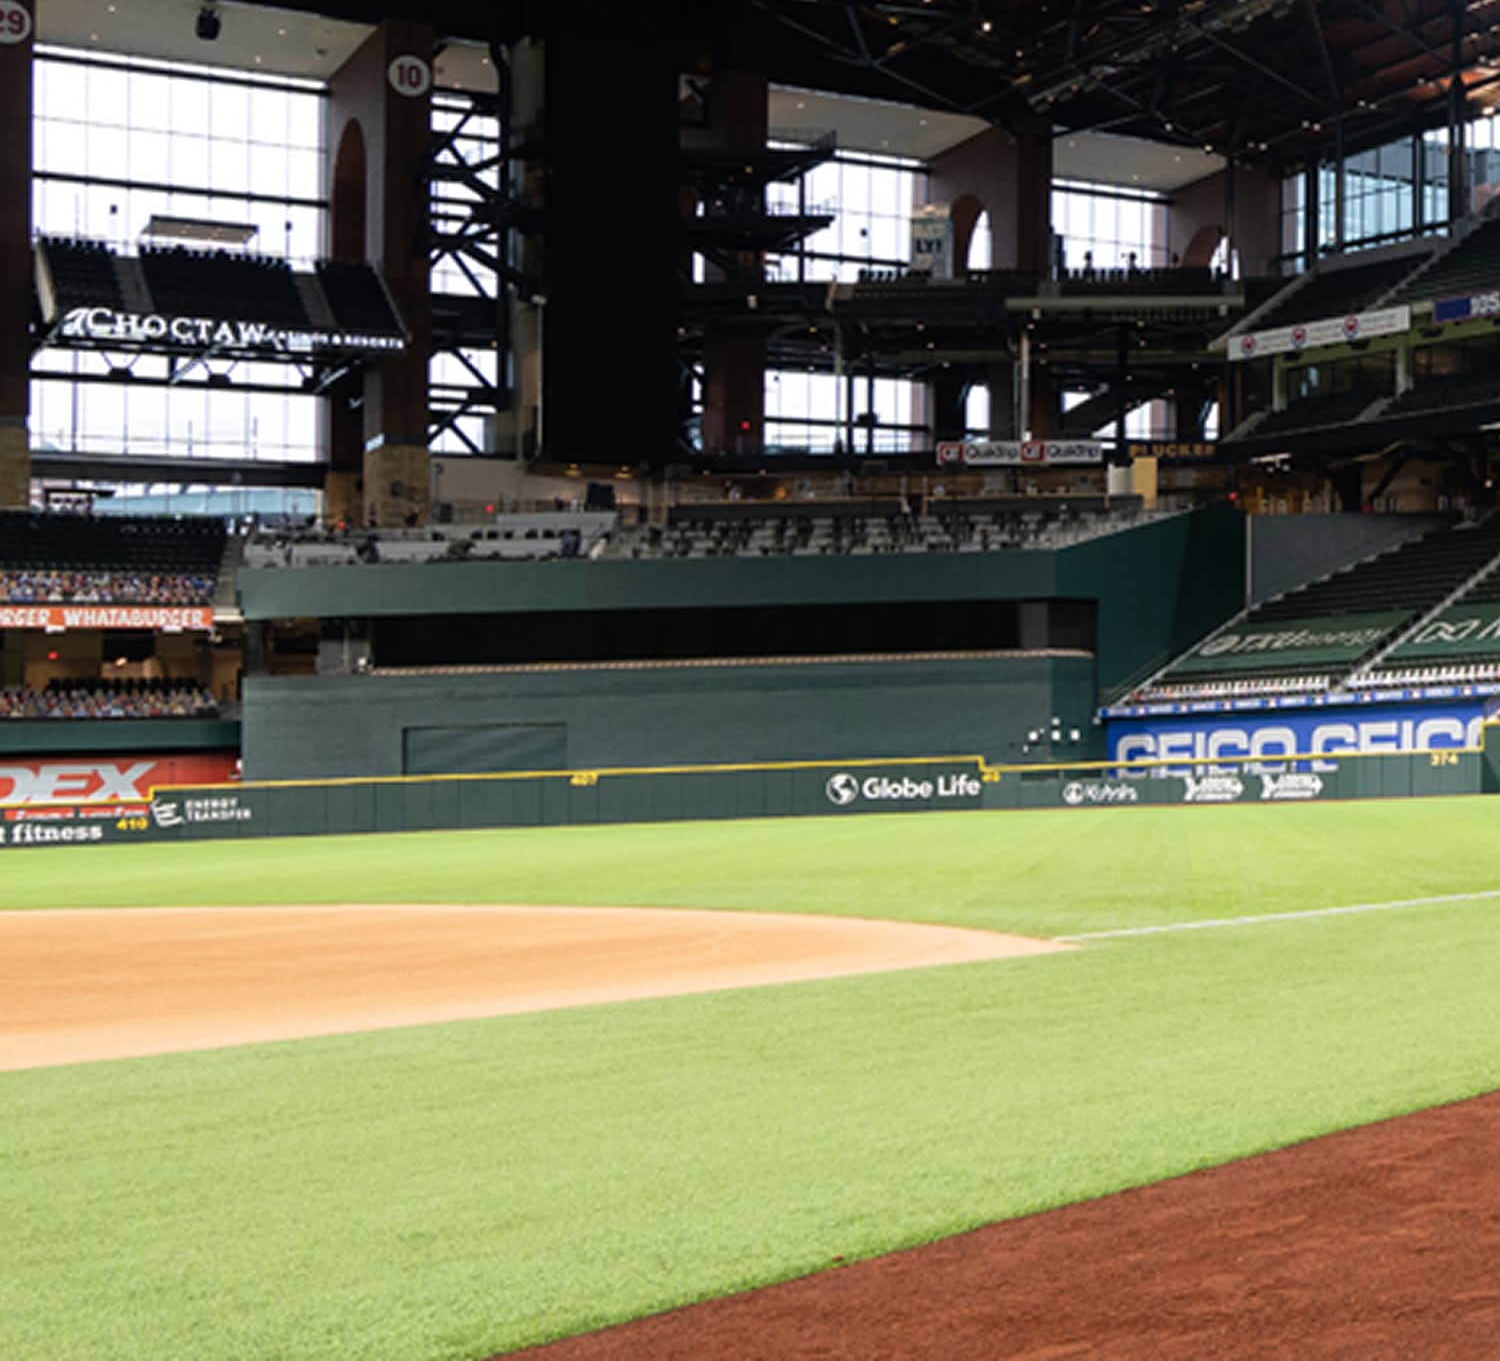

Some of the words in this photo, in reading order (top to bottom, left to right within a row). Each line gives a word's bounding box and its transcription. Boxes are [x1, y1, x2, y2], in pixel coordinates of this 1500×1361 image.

[398, 63, 422, 88] 10
[88, 308, 265, 342] CHOCTAW
[64, 609, 204, 627] WHATABURGER
[1115, 726, 1298, 779] GEICO
[1430, 752, 1459, 767] 374
[862, 776, 933, 799] Globe
[937, 773, 981, 796] Life
[12, 823, 103, 843] fitness
